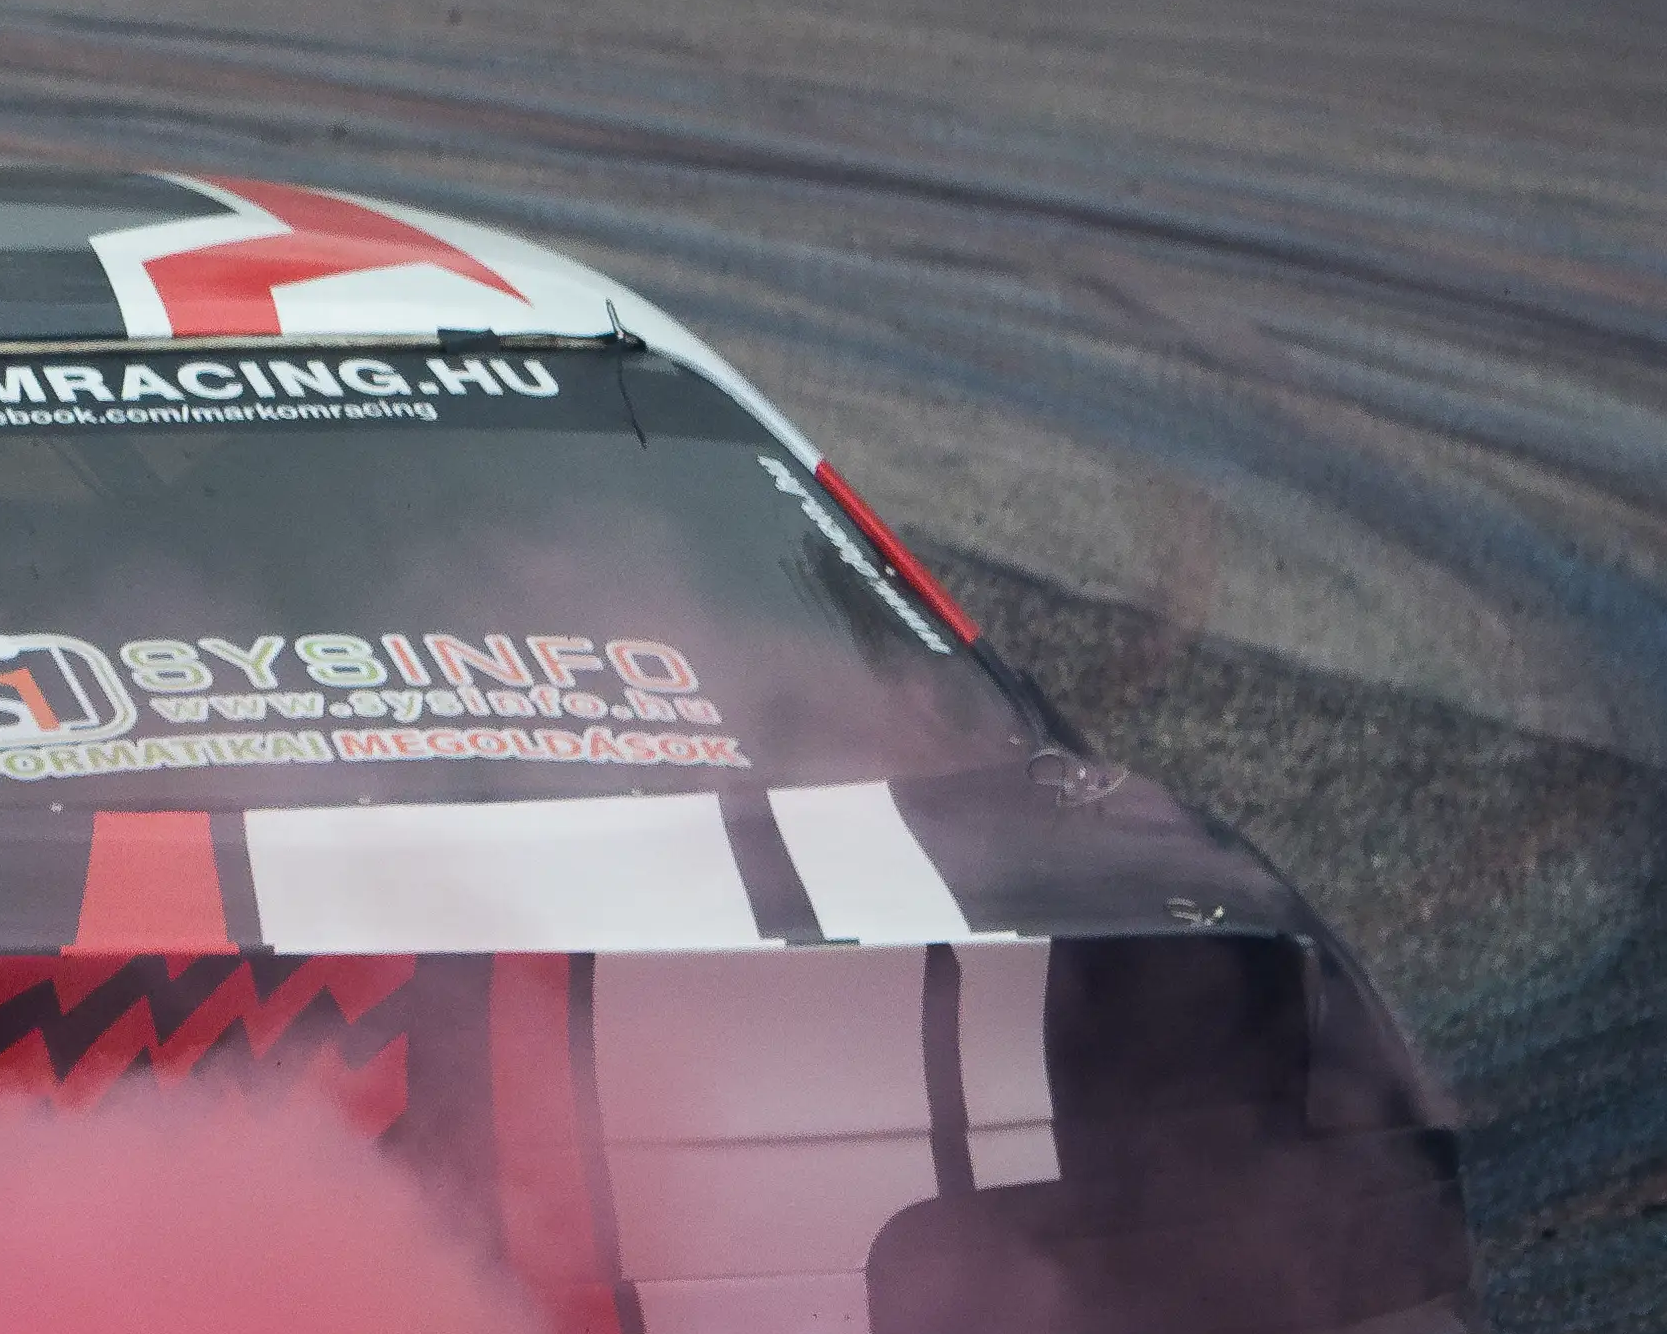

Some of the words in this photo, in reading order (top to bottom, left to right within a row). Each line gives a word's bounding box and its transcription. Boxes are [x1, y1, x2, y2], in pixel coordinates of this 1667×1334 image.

[120, 634, 699, 693] SYSINFO
[151, 686, 721, 724] www.sysinfo.hu
[332, 726, 751, 768] MEGOLDÁSOK
